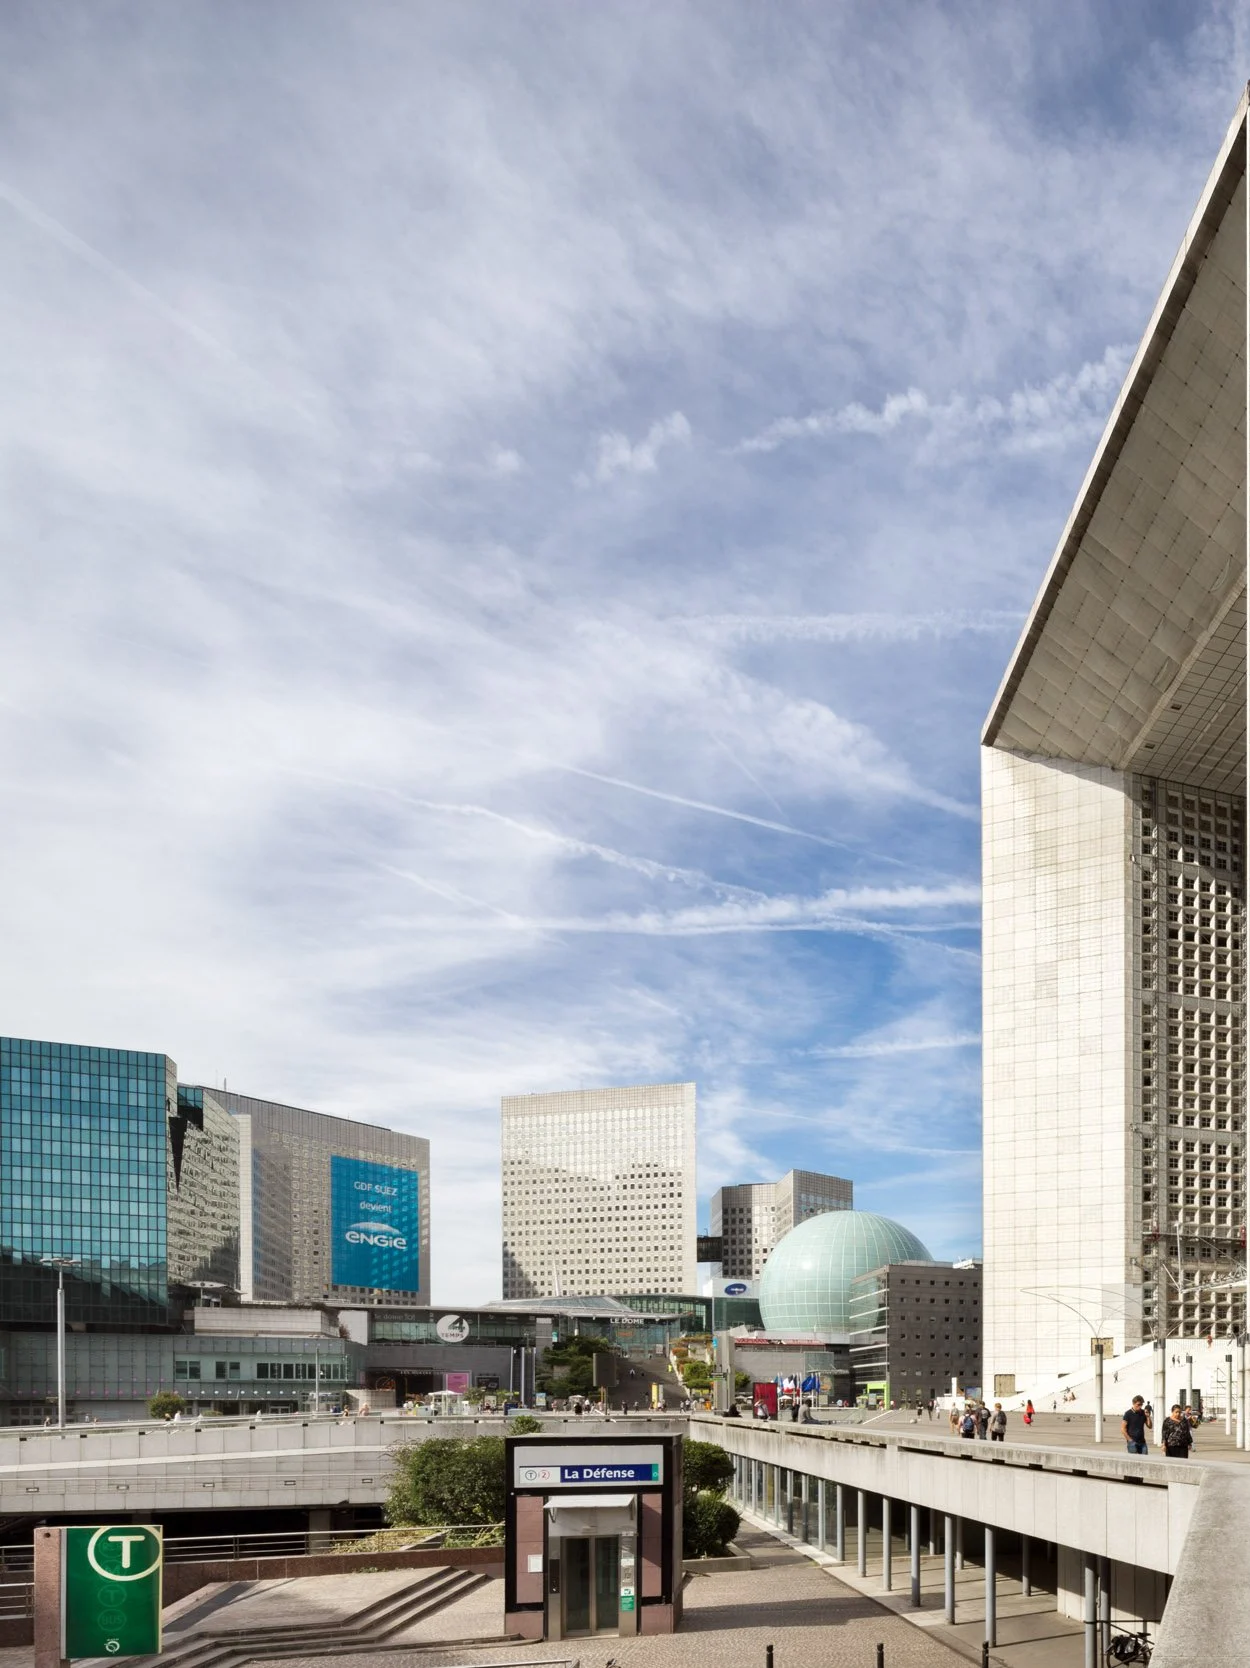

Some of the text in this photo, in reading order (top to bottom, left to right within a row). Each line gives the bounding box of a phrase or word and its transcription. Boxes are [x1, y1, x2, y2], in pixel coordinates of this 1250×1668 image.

[354, 1181, 398, 1196] GDF SUEZ
[360, 1201, 392, 1213] devient
[448, 1316, 465, 1333] 4
[564, 1469, 579, 1479] La
[583, 1468, 635, 1479] Défense
[108, 1535, 145, 1569] T
